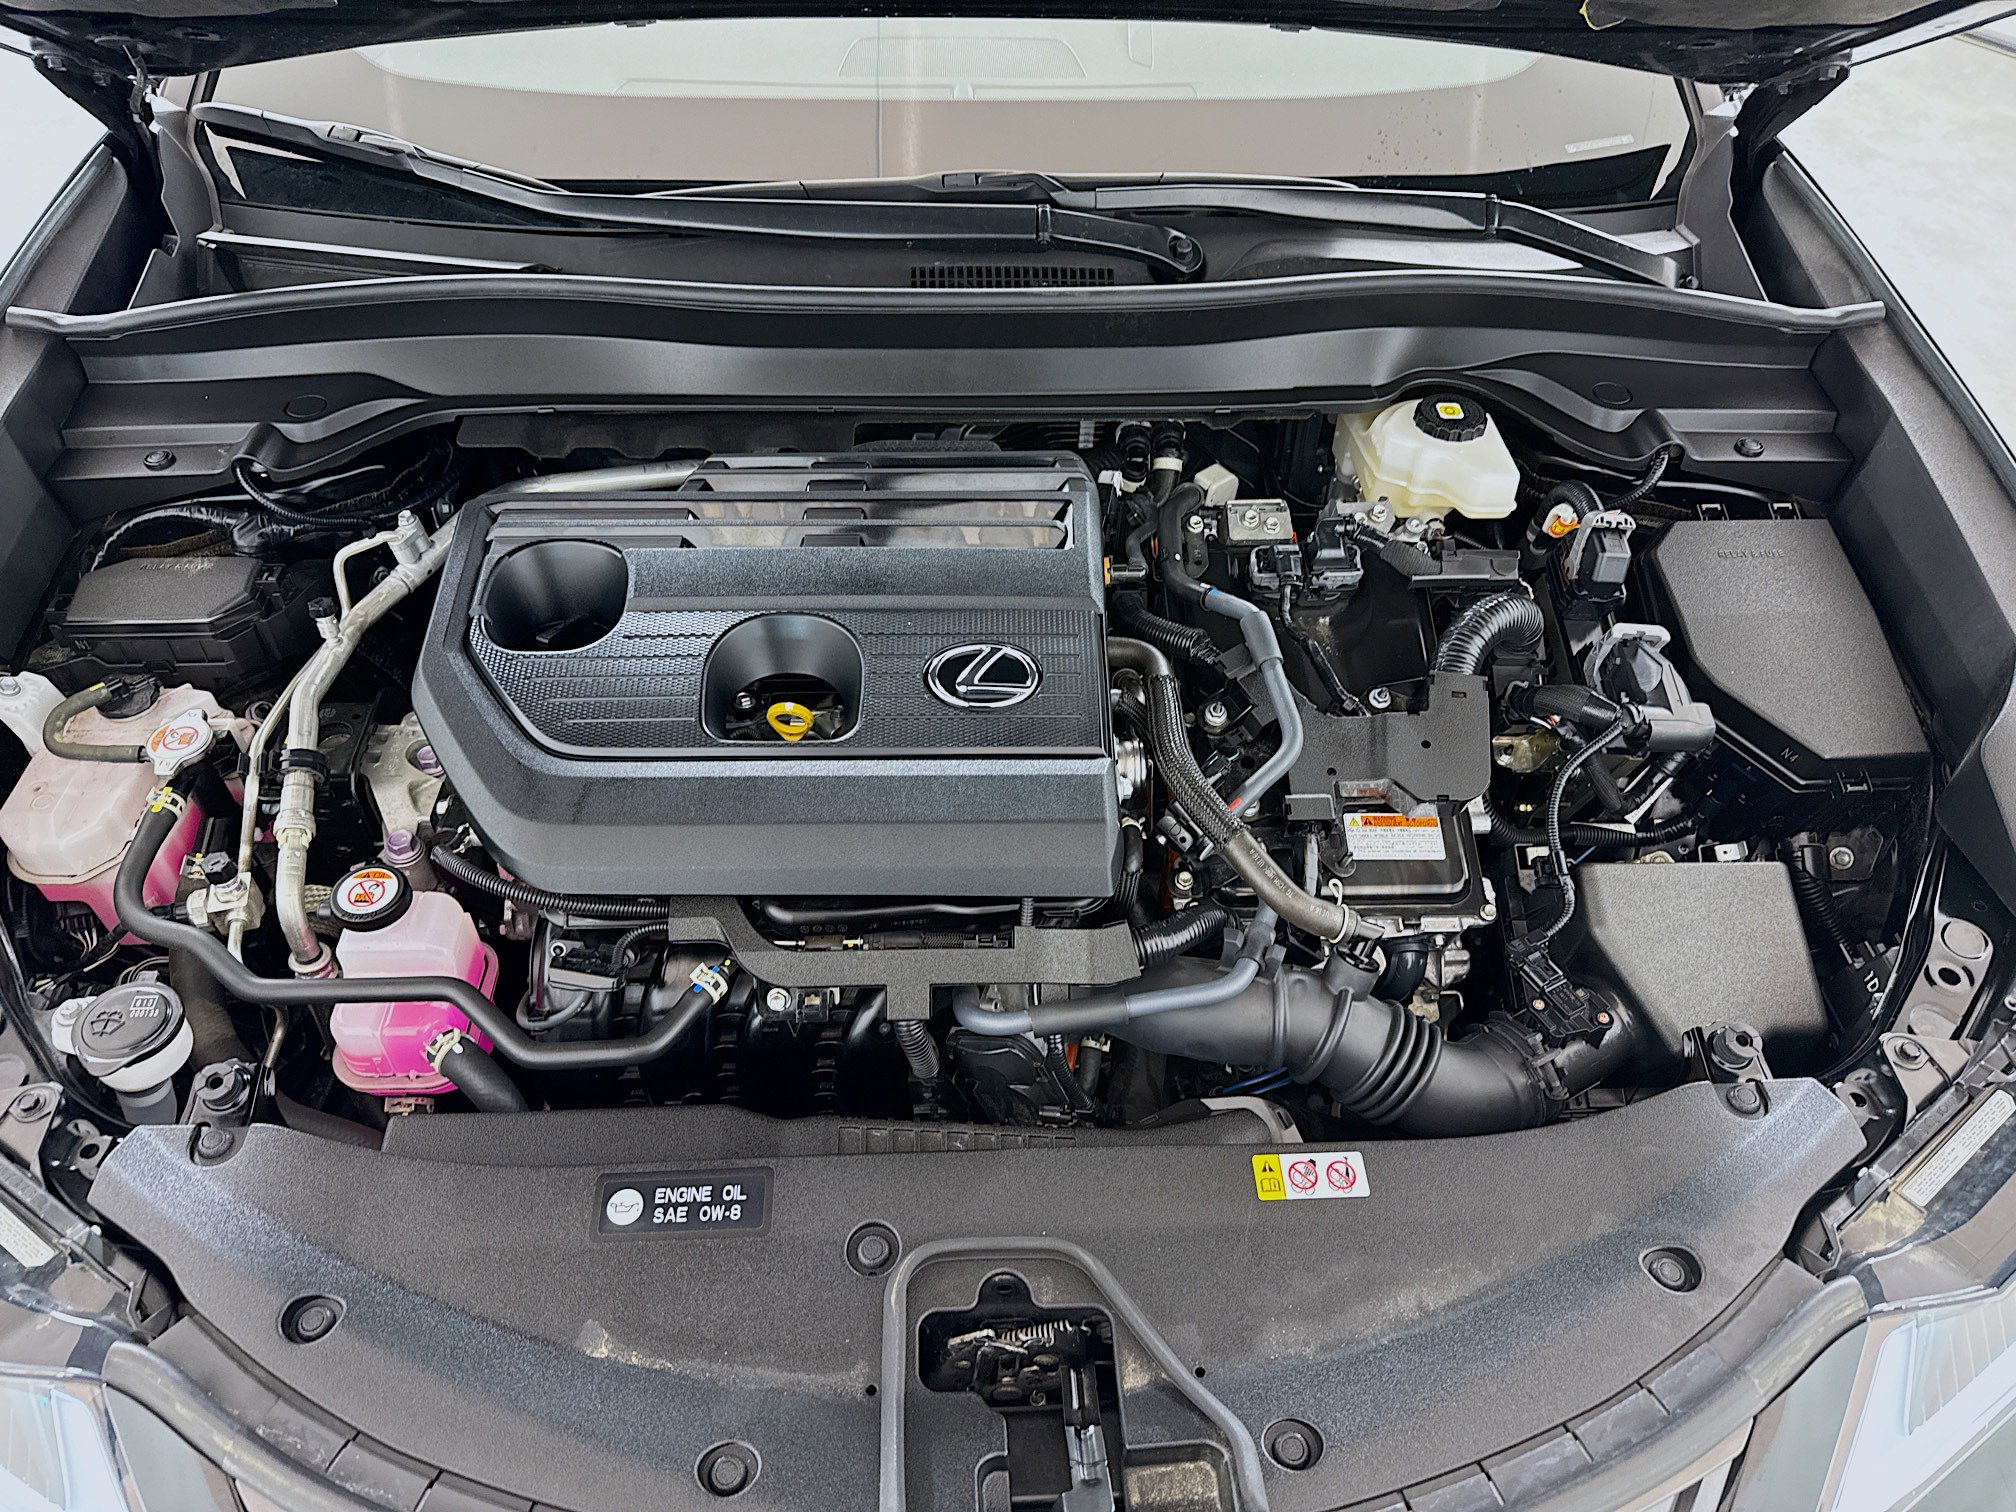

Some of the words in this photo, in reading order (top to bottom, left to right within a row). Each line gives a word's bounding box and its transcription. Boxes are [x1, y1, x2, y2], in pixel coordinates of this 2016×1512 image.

[74, 639, 92, 650] N1
[1780, 747, 1799, 763] N4
[654, 1185, 713, 1204] ENGINE
[722, 1184, 747, 1202] OIL
[652, 1206, 689, 1224] SAE
[699, 1204, 742, 1222] 0W-8
